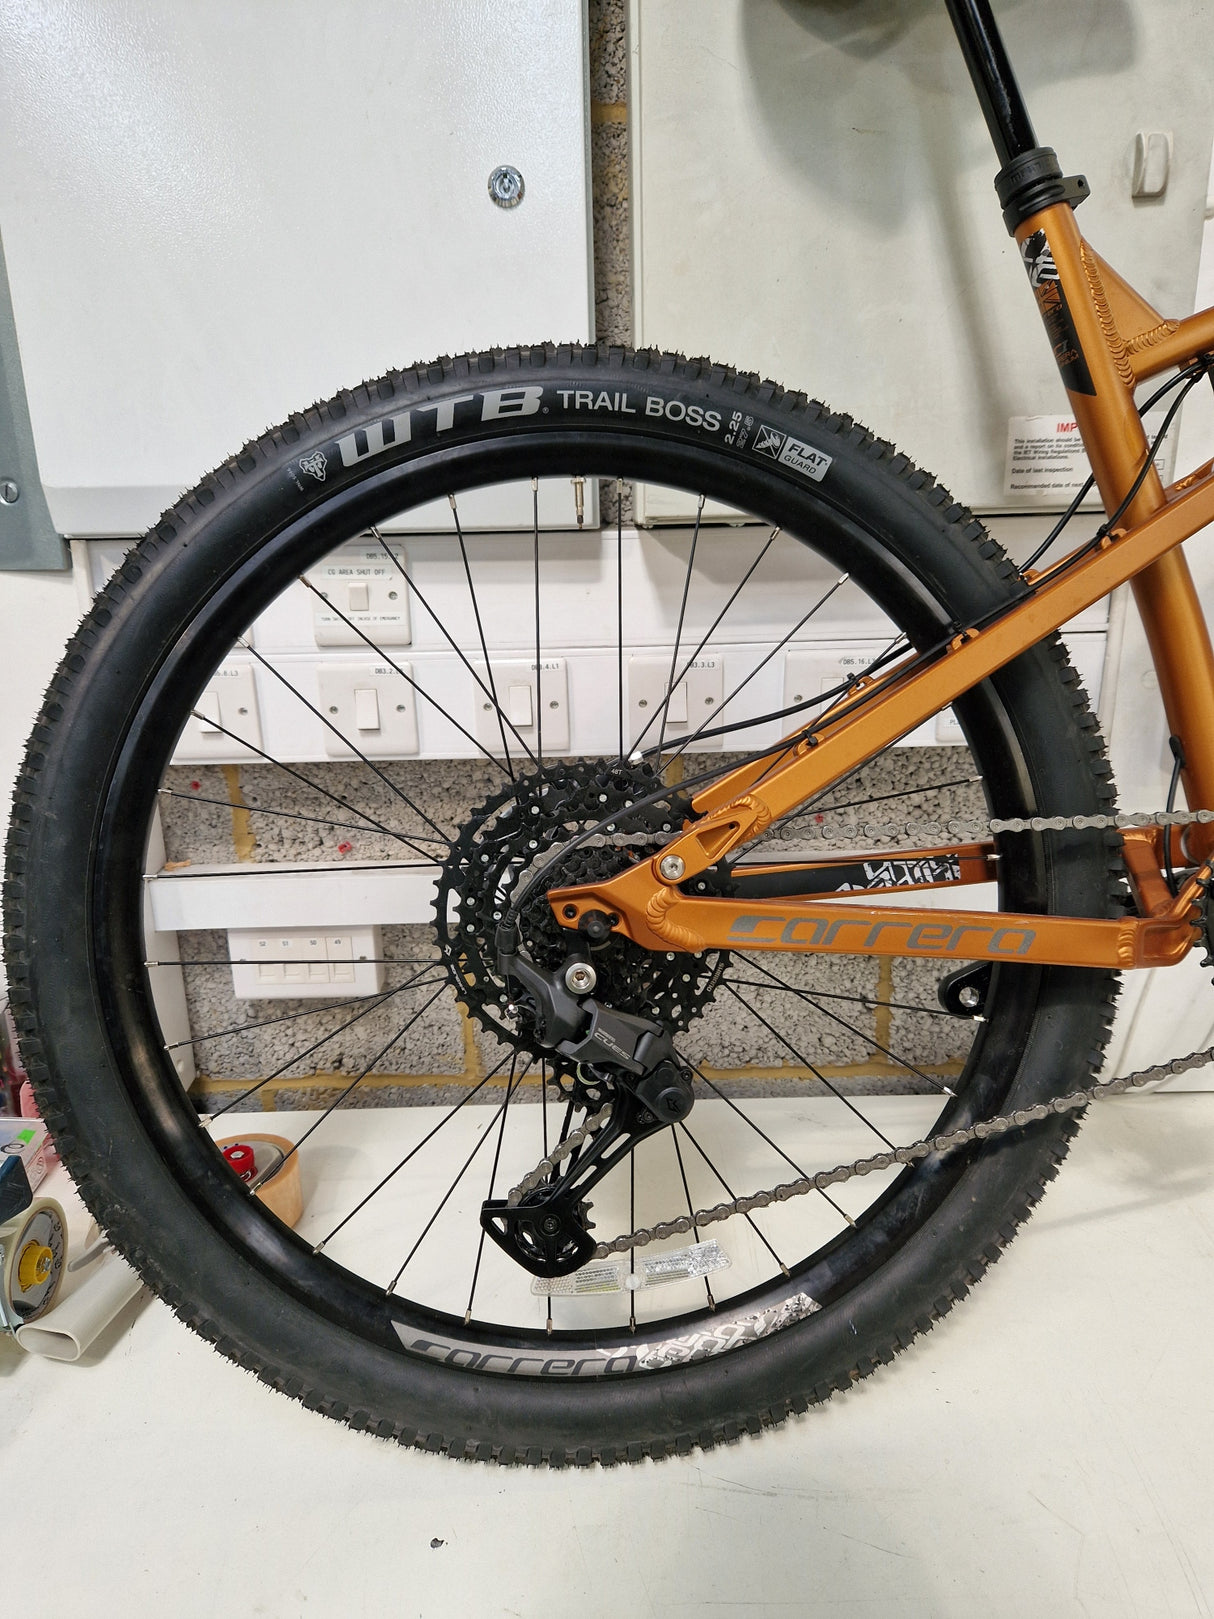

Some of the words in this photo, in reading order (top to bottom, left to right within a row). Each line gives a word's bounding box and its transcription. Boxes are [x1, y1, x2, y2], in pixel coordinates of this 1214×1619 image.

[334, 386, 544, 467] WTB
[556, 390, 636, 414] TRAIL
[645, 396, 722, 432] BOSS
[724, 410, 743, 445] 2.25
[783, 454, 817, 474] GUARD
[788, 443, 827, 466] FLAT
[594, 1032, 631, 1060] CUES
